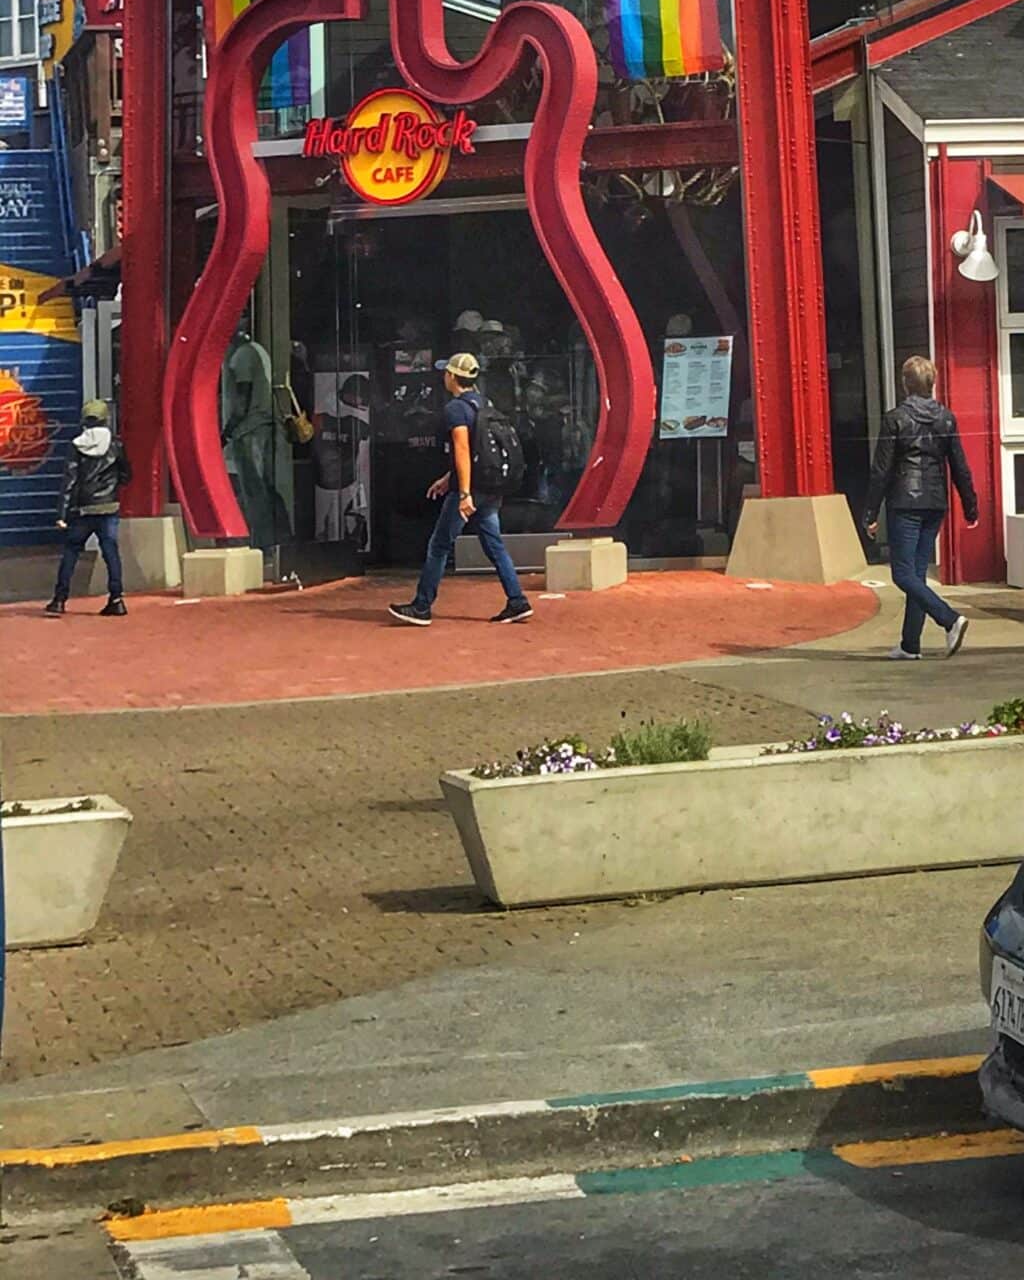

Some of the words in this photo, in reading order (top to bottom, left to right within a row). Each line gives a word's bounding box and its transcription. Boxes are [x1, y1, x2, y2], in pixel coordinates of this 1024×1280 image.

[303, 113, 392, 157] Hard
[392, 109, 477, 160] Rock
[371, 166, 415, 184] CAFE
